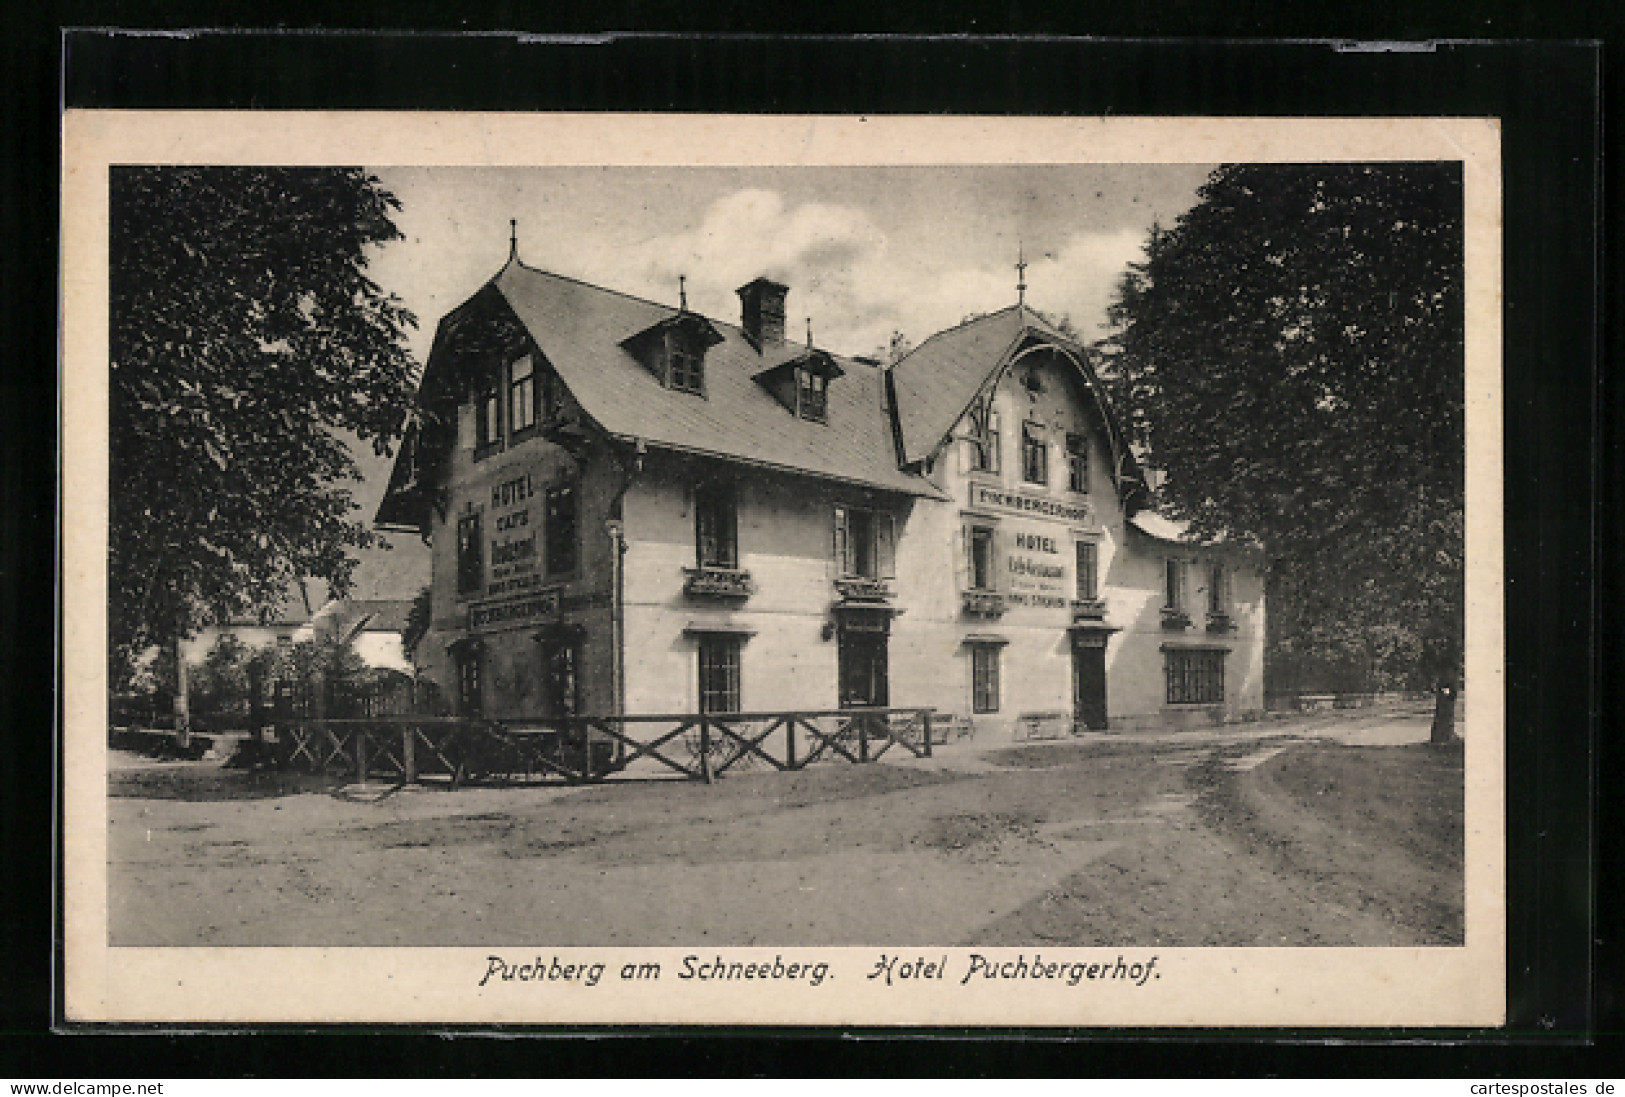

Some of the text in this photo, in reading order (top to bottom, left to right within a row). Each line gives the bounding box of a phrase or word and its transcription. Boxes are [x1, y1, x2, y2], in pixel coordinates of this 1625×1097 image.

[491, 473, 534, 508] HOTEL
[1016, 532, 1059, 554] HOTEL
[478, 954, 1161, 987] Puchberg am Schneeberg. Hotel Puchbergerhof.
